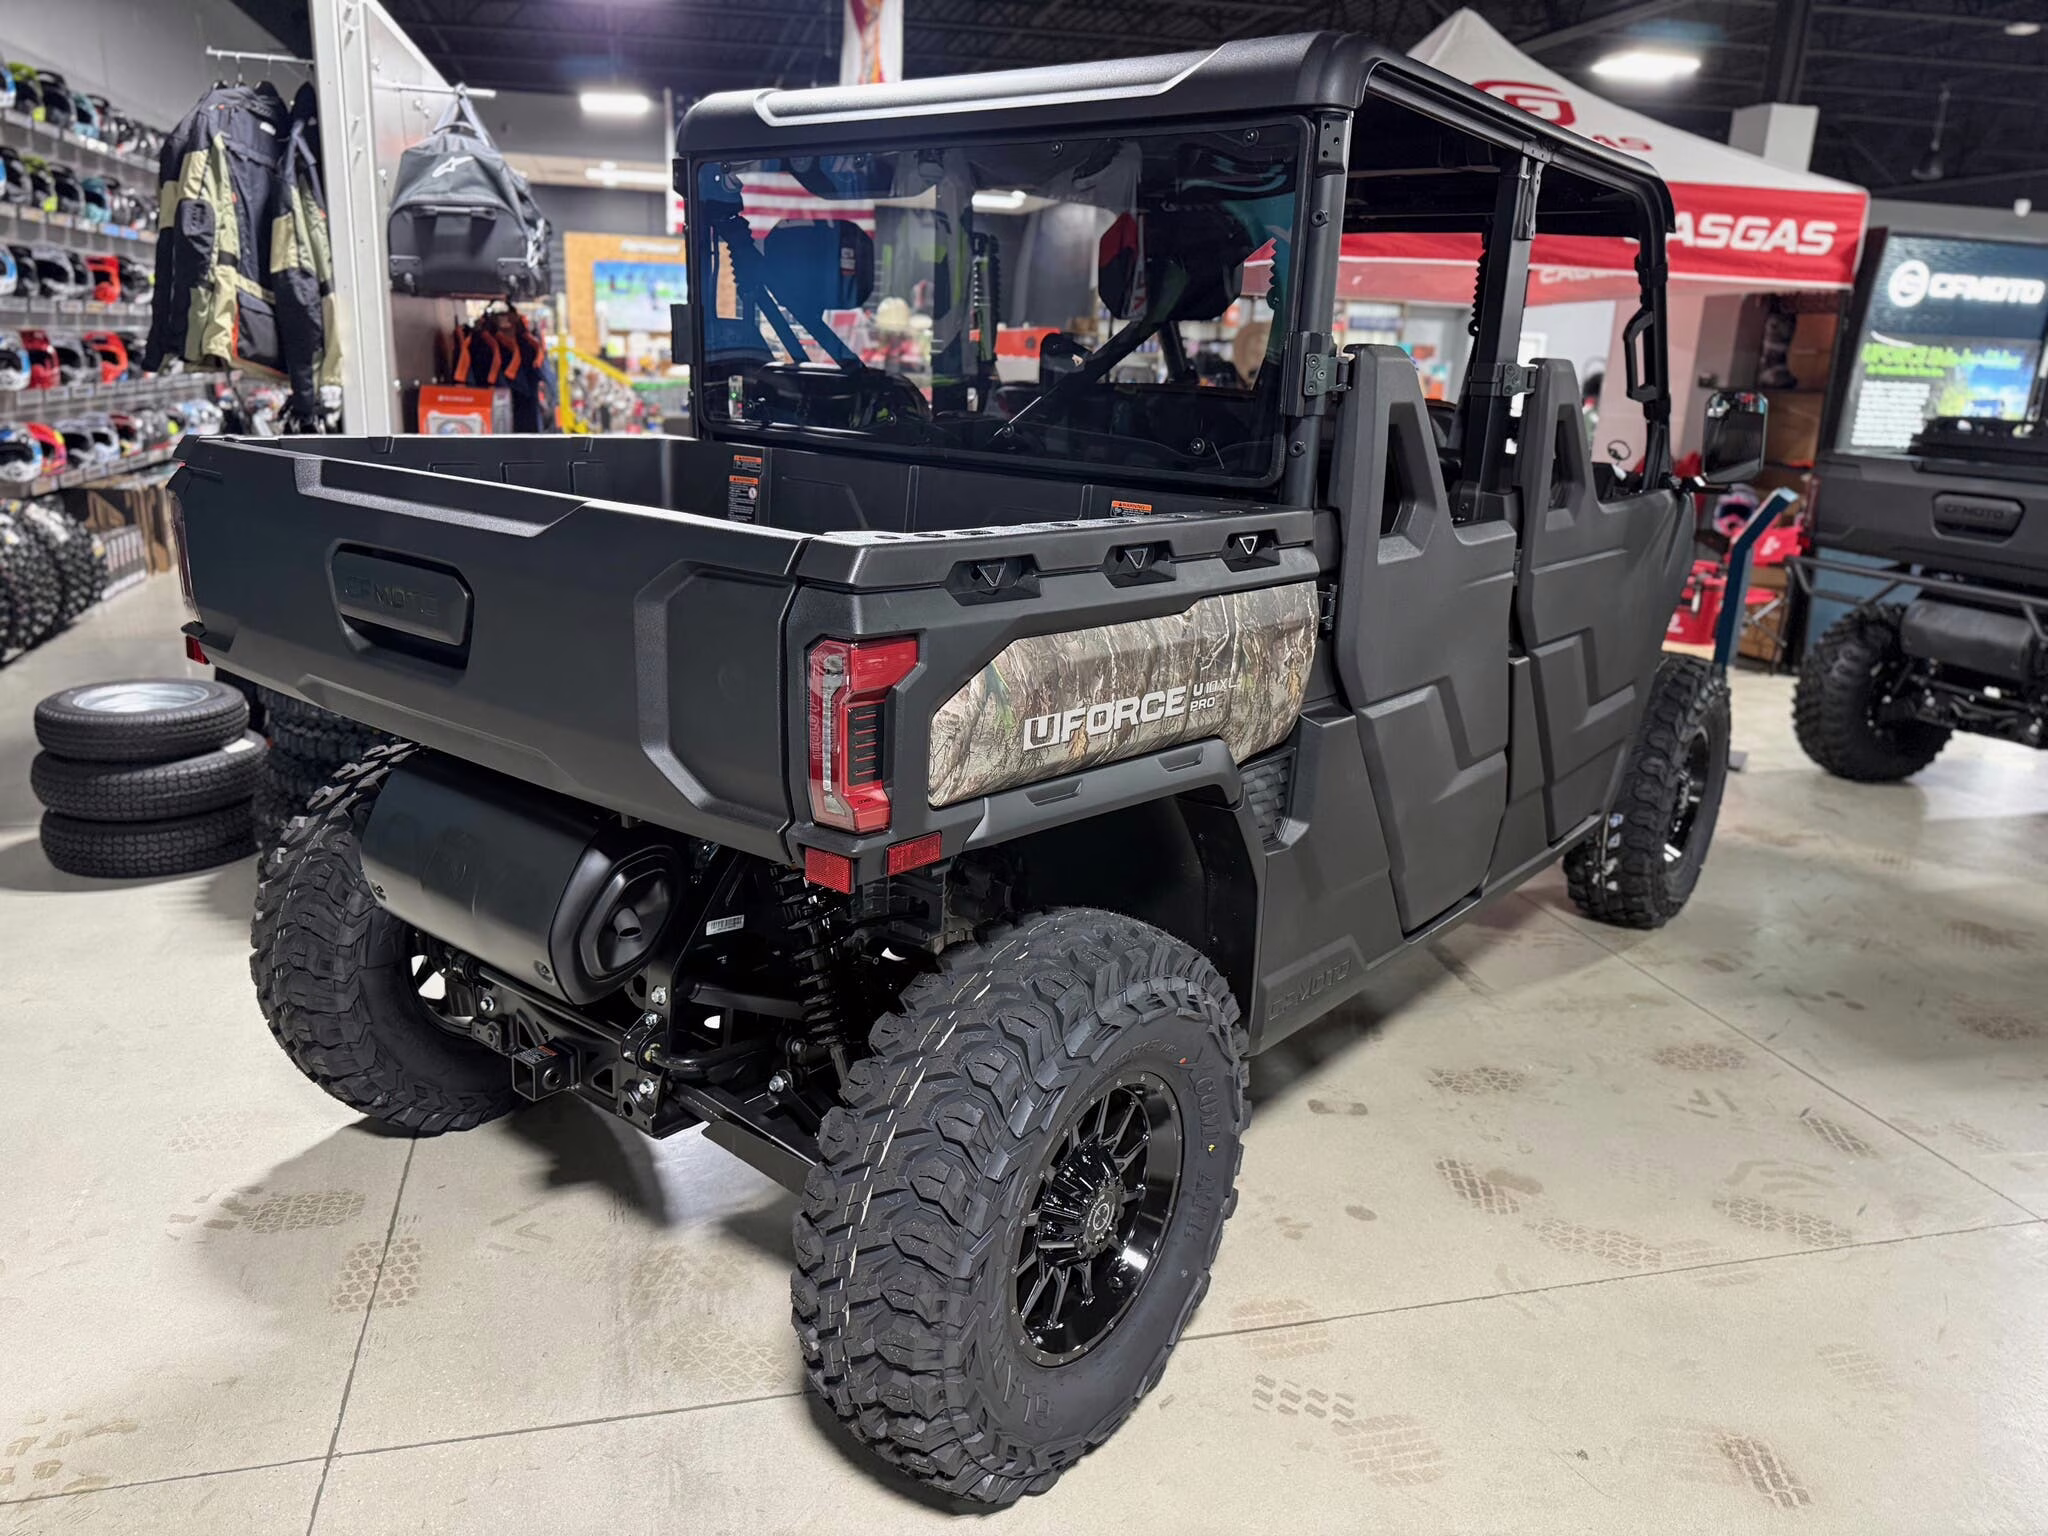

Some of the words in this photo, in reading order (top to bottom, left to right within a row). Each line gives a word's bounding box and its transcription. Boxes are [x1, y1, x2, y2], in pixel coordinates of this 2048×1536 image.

[1624, 212, 1837, 255] ASGAS
[1928, 273, 2046, 304] CFMOTO
[1023, 686, 1187, 750] UFORCE
[1190, 697, 1215, 712] PRO
